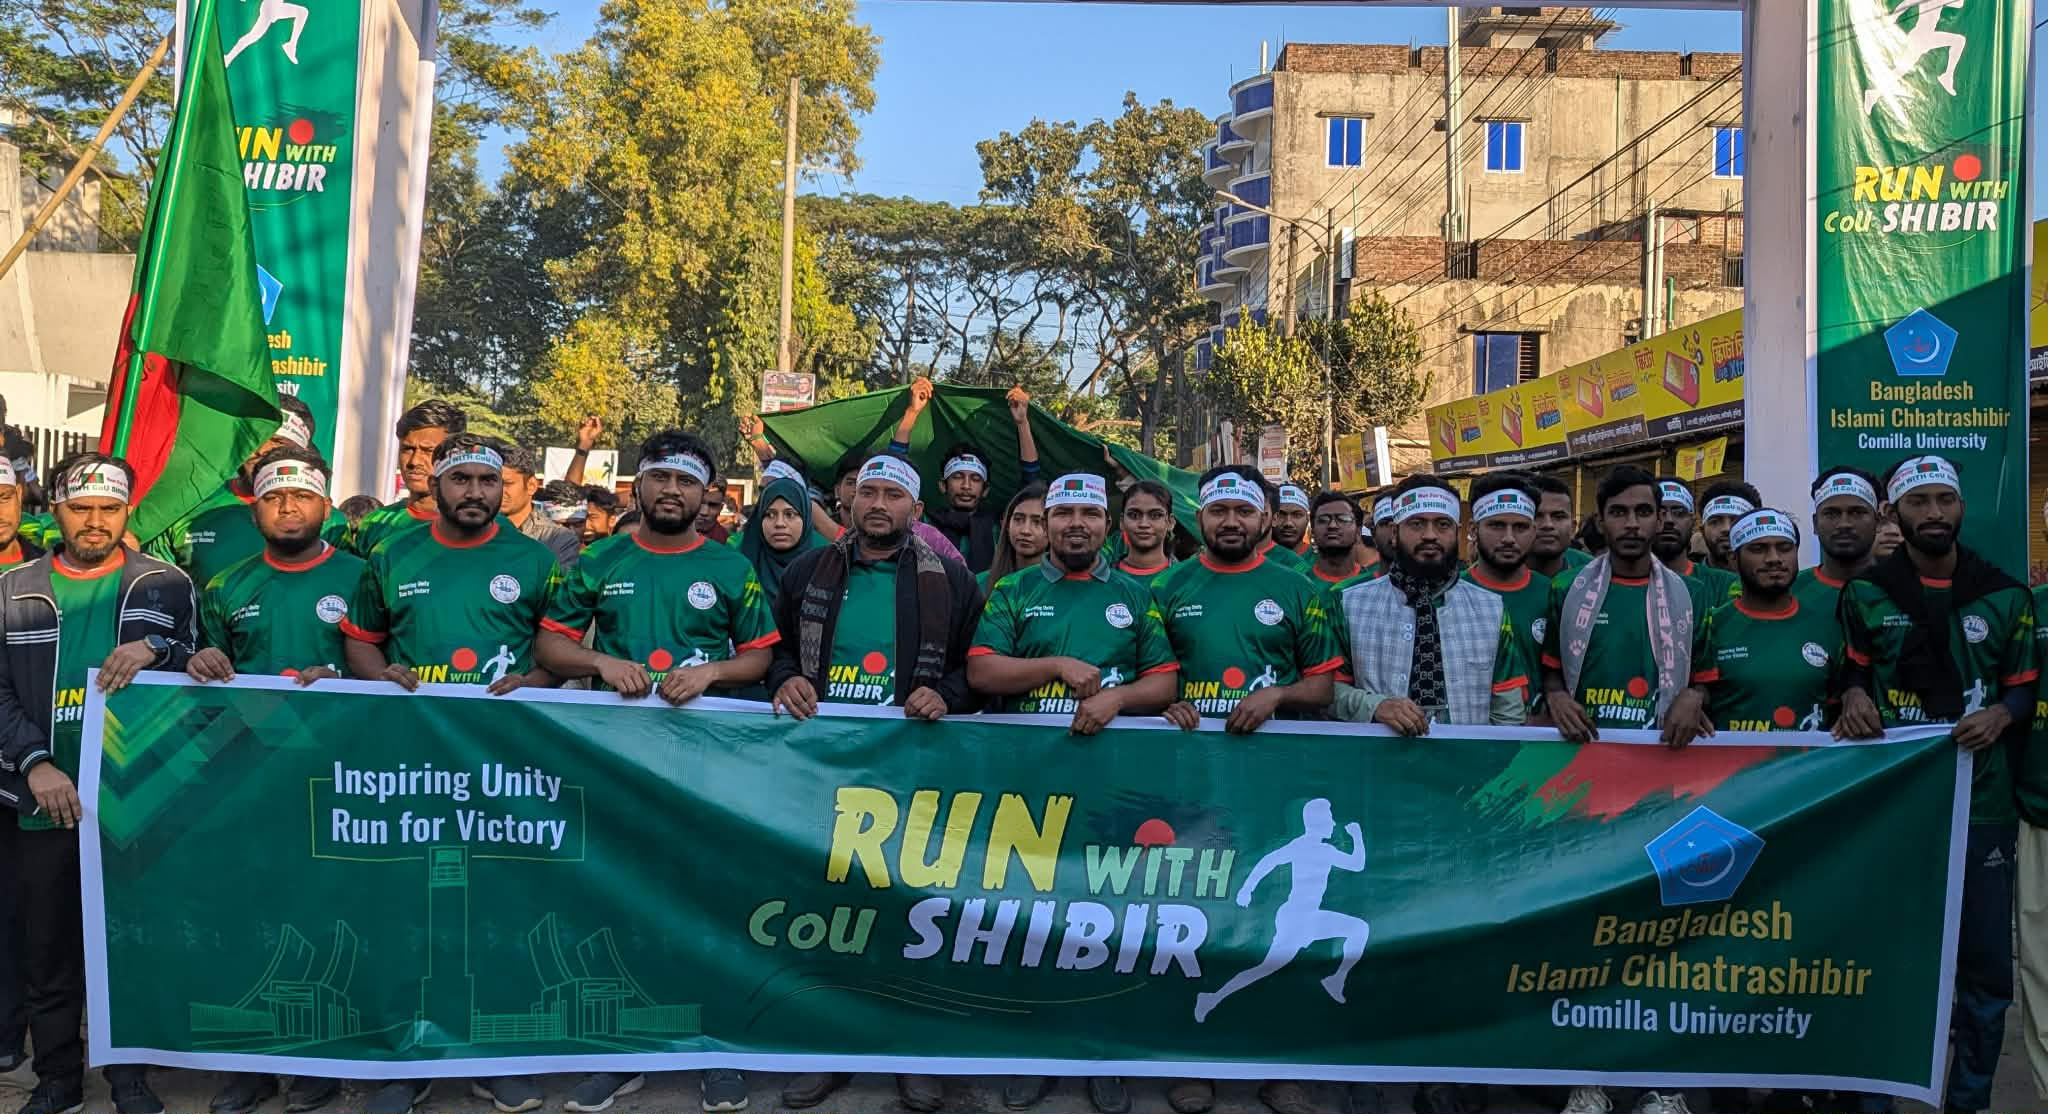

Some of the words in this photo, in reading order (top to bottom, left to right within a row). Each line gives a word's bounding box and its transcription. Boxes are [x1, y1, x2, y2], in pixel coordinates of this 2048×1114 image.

[236, 127, 283, 160] UN
[285, 144, 337, 162] WITH
[243, 162, 326, 192] HIBIR
[1854, 165, 1944, 202] RUN
[1950, 181, 2008, 200] WITH
[1824, 211, 1873, 233] CoU
[1882, 201, 1998, 232] SHIBIR
[272, 355, 327, 376] ashibir
[1870, 381, 1973, 404] Bangladesh
[1831, 408, 1885, 428] Islami
[1891, 407, 2010, 428] Chhatrashibir
[1858, 433, 1912, 450] Comilla
[1916, 432, 1988, 451] University
[663, 455, 679, 465] CoU
[1072, 491, 1088, 499] CoU
[410, 665, 448, 683] UN
[450, 672, 481, 682] WITH
[828, 666, 858, 683] UN
[860, 675, 888, 685] WITH
[828, 683, 883, 700] SHIBIR
[1185, 681, 1220, 699] RUN
[1586, 688, 1624, 706] RUN
[56, 706, 83, 723] SHI
[1598, 705, 1647, 722] SHIBIR
[334, 761, 471, 803] Inspiring
[482, 763, 562, 802] Unity
[331, 808, 388, 844] Run
[400, 811, 446, 843] for
[456, 809, 567, 850] Victory
[826, 787, 1074, 892] RUN
[1085, 845, 1236, 898] WITH
[1593, 900, 1793, 948] Bangladesh
[748, 900, 877, 954] CoU
[903, 897, 1208, 977] SHIBIR
[1506, 957, 1614, 993] Islami
[1621, 951, 1873, 996] Chhatrashibir
[1551, 997, 1659, 1033] Comilla
[1669, 1001, 1813, 1039] University
